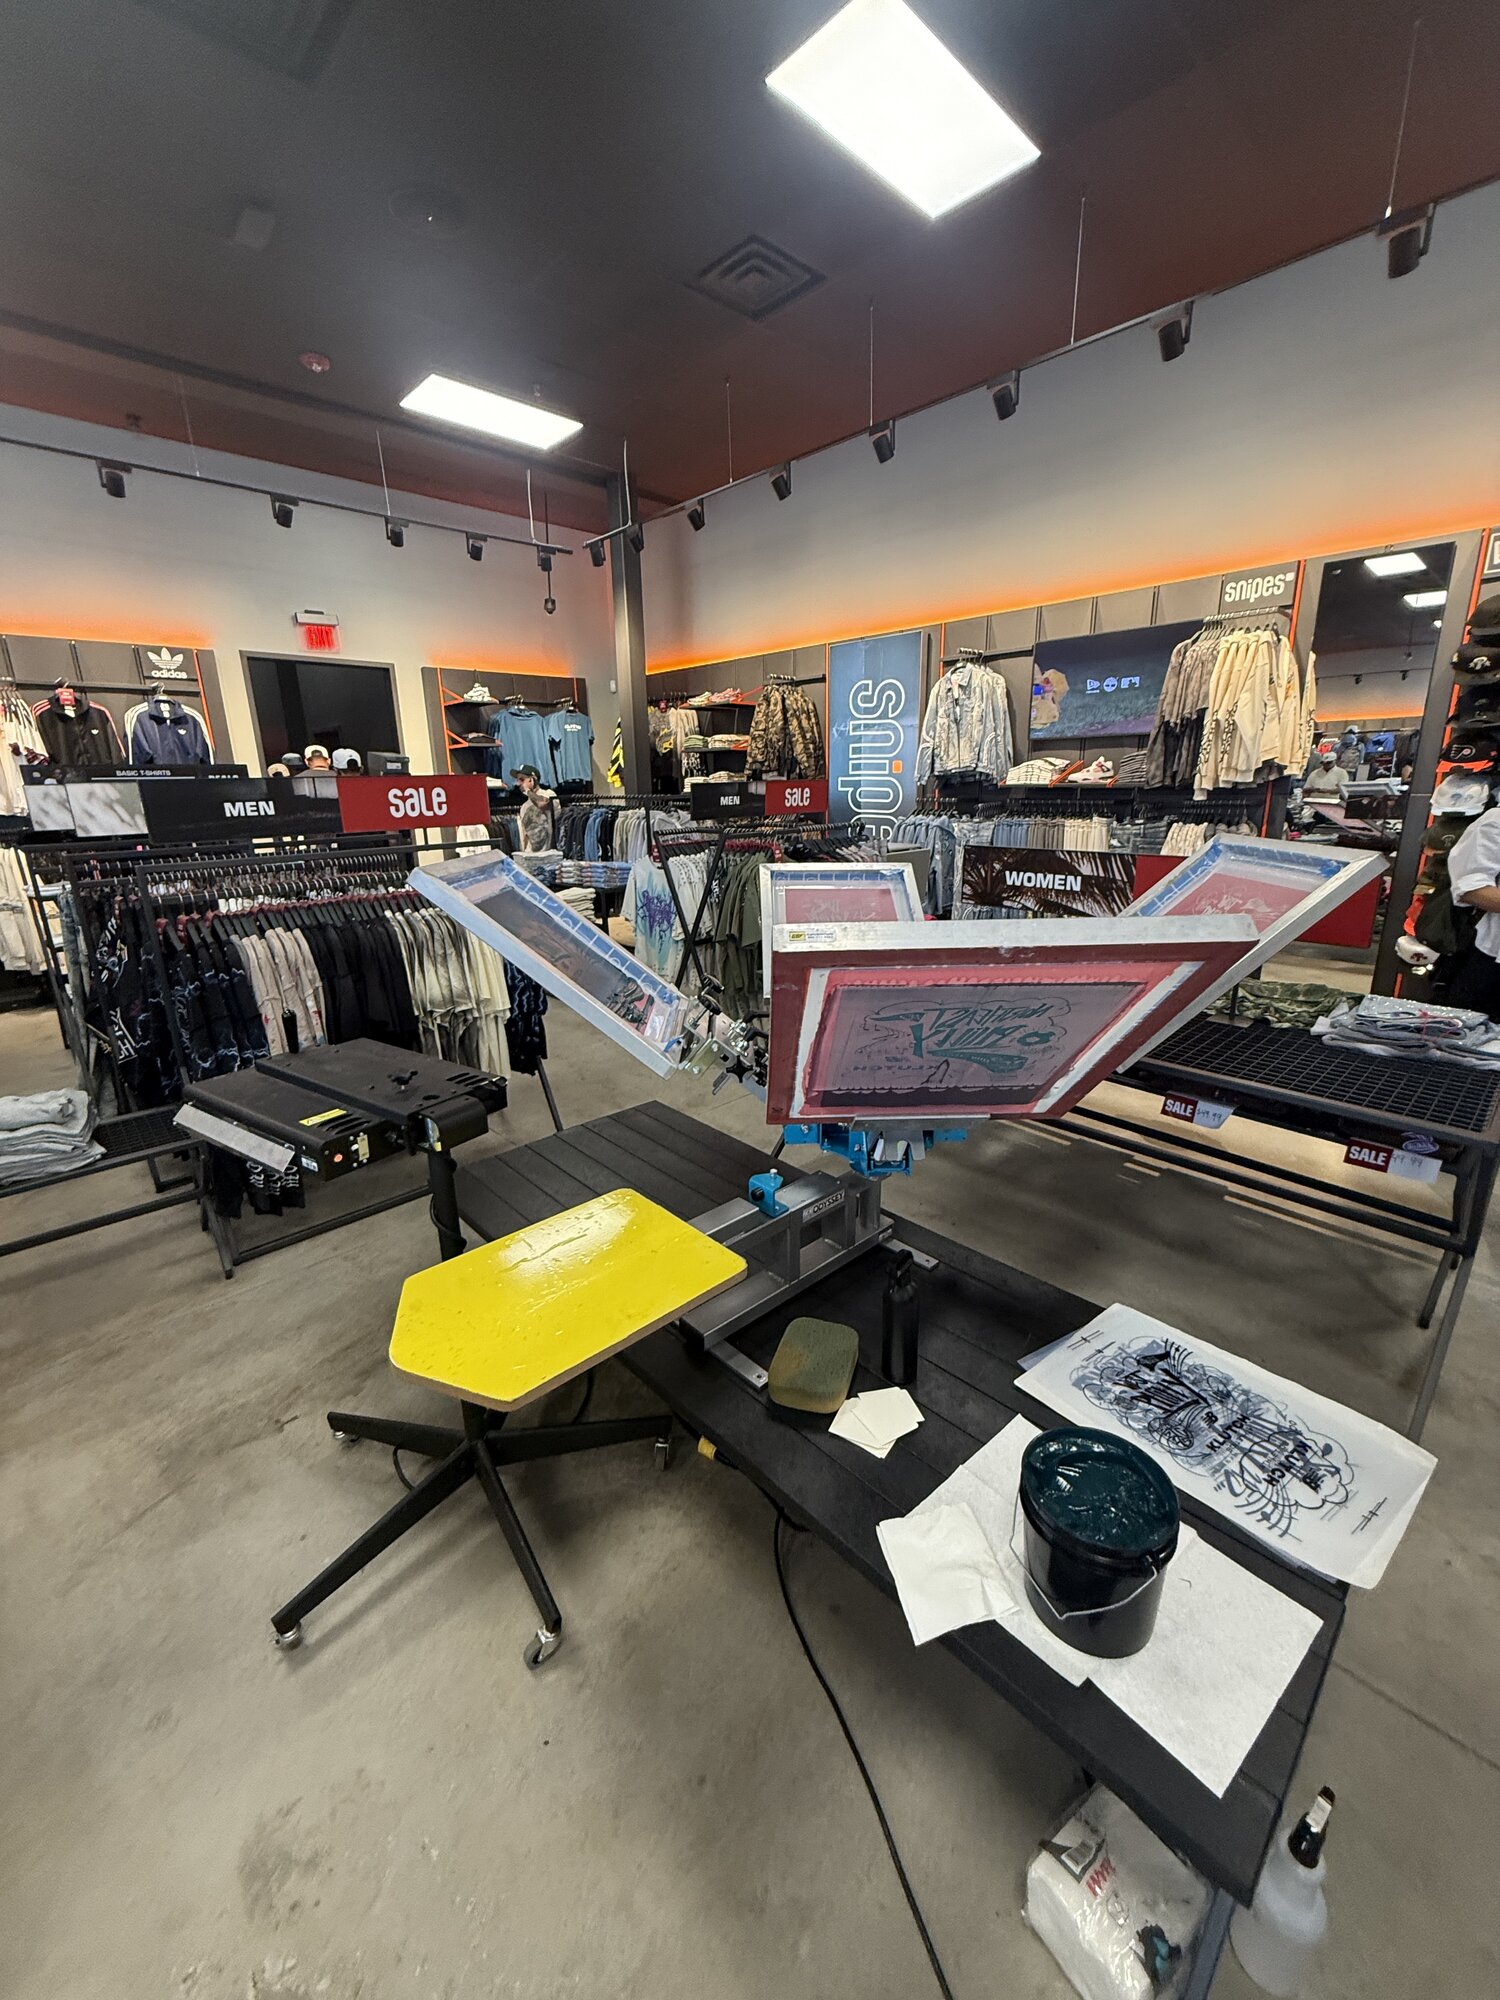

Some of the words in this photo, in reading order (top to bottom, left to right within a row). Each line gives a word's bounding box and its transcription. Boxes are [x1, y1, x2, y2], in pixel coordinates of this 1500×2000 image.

[1224, 573, 1286, 603] snipes
[305, 625, 335, 649] EXIT
[151, 669, 188, 679] adidas
[115, 769, 139, 777] BASIC
[223, 800, 276, 818] MEN
[720, 795, 740, 806] MEN
[1004, 870, 1082, 892] WOMEN
[1164, 1099, 1194, 1117] SALE
[1348, 1145, 1388, 1166] SALE
[812, 1192, 844, 1214] ODYSSEY
[1206, 1413, 1251, 1453] KLUTCH
